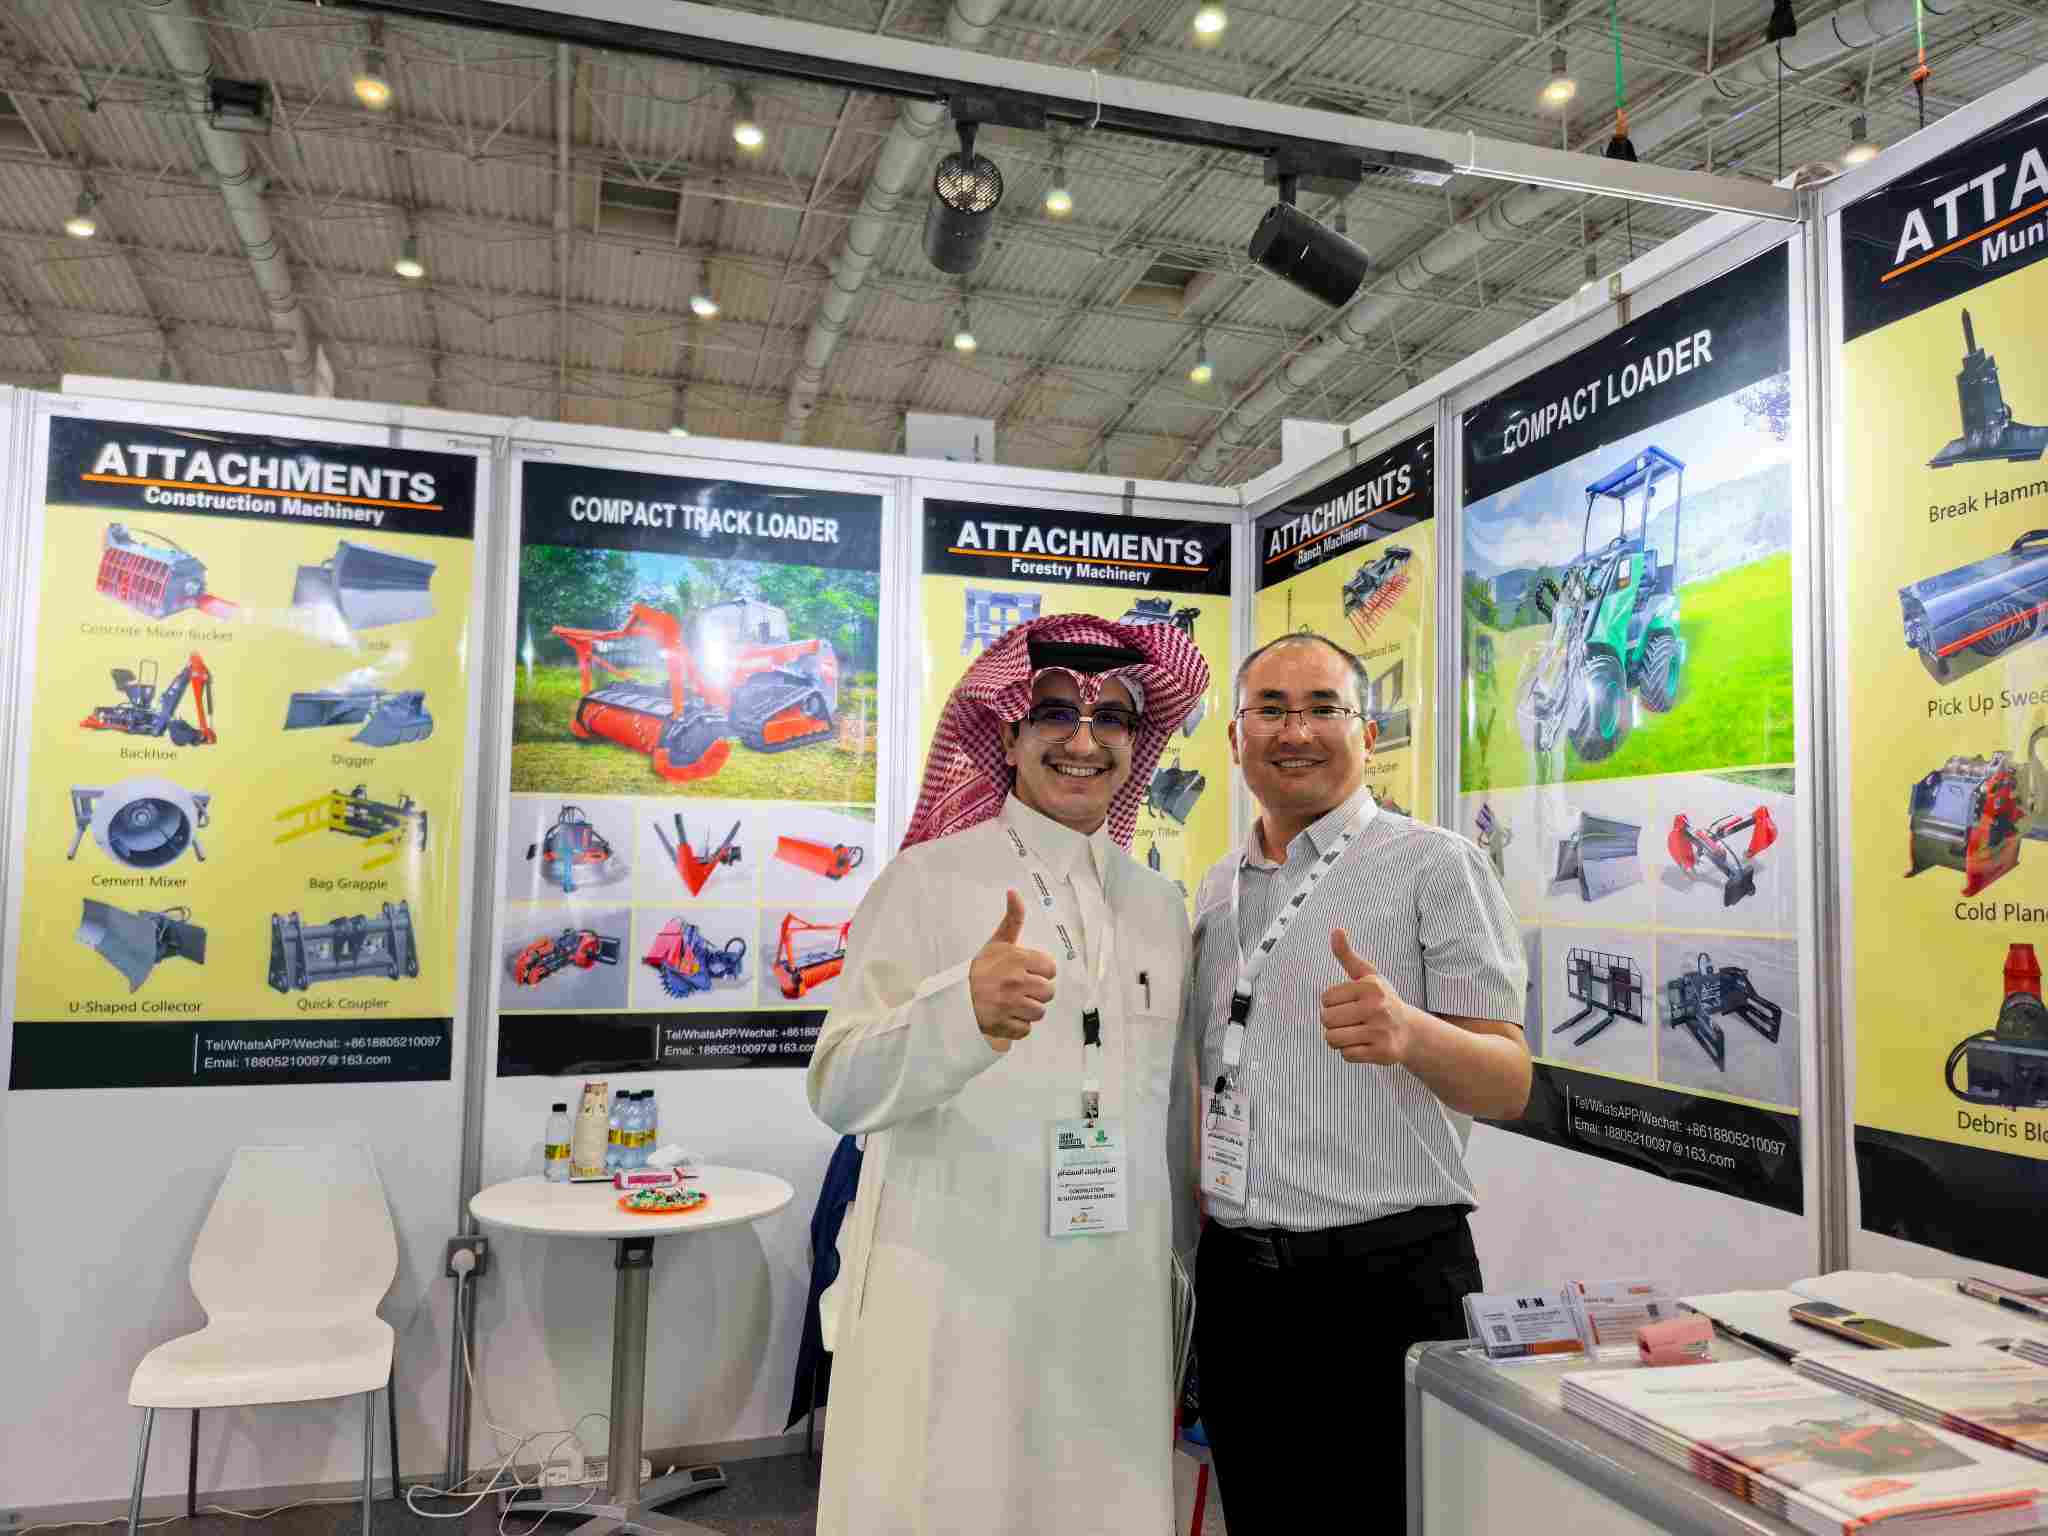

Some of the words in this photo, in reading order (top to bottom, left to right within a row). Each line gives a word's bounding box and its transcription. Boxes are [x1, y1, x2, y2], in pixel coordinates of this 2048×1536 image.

[1981, 218, 2048, 266] Mun
[1501, 380, 1603, 455] COMPACT
[1605, 328, 1713, 407] LOADER
[94, 441, 436, 503] ATTACHMENTS
[144, 486, 278, 515] Construction
[281, 498, 385, 527] Machinery
[1269, 463, 1411, 558] ATTACHMENTS
[1928, 495, 1979, 524] Break
[1984, 479, 2048, 510] Hamm
[570, 496, 677, 531] COMPACT
[680, 503, 753, 536] TRACK
[756, 512, 840, 545] LOADER
[956, 519, 1204, 566] ATTACHMENTS
[1297, 543, 1323, 565] Ranch
[1322, 523, 1368, 553] Machinery
[1011, 558, 1073, 579] Forestry
[1076, 563, 1151, 585] Machinery
[1928, 699, 1963, 718] Pick
[1968, 695, 1995, 717] Up
[2000, 689, 2048, 708] Swee
[119, 747, 178, 761] Backhoe
[331, 753, 377, 769] Digger
[90, 874, 145, 888] Cement
[149, 875, 189, 889] Mixer
[309, 877, 334, 892] Bag
[336, 877, 389, 892] Grapple
[1954, 901, 1997, 921] Cold
[2004, 902, 2048, 923] Plan
[68, 999, 138, 1016] U-Shaped
[140, 999, 202, 1014] Collector
[296, 996, 333, 1011] Quick
[335, 997, 391, 1011] Coupler
[204, 1037, 339, 1051] Tel/WhatsAPP/Wechat:
[343, 1035, 442, 1050] +8618805210097
[1957, 1110, 2018, 1139] Debris
[1686, 1122, 1786, 1157] +8618805210097
